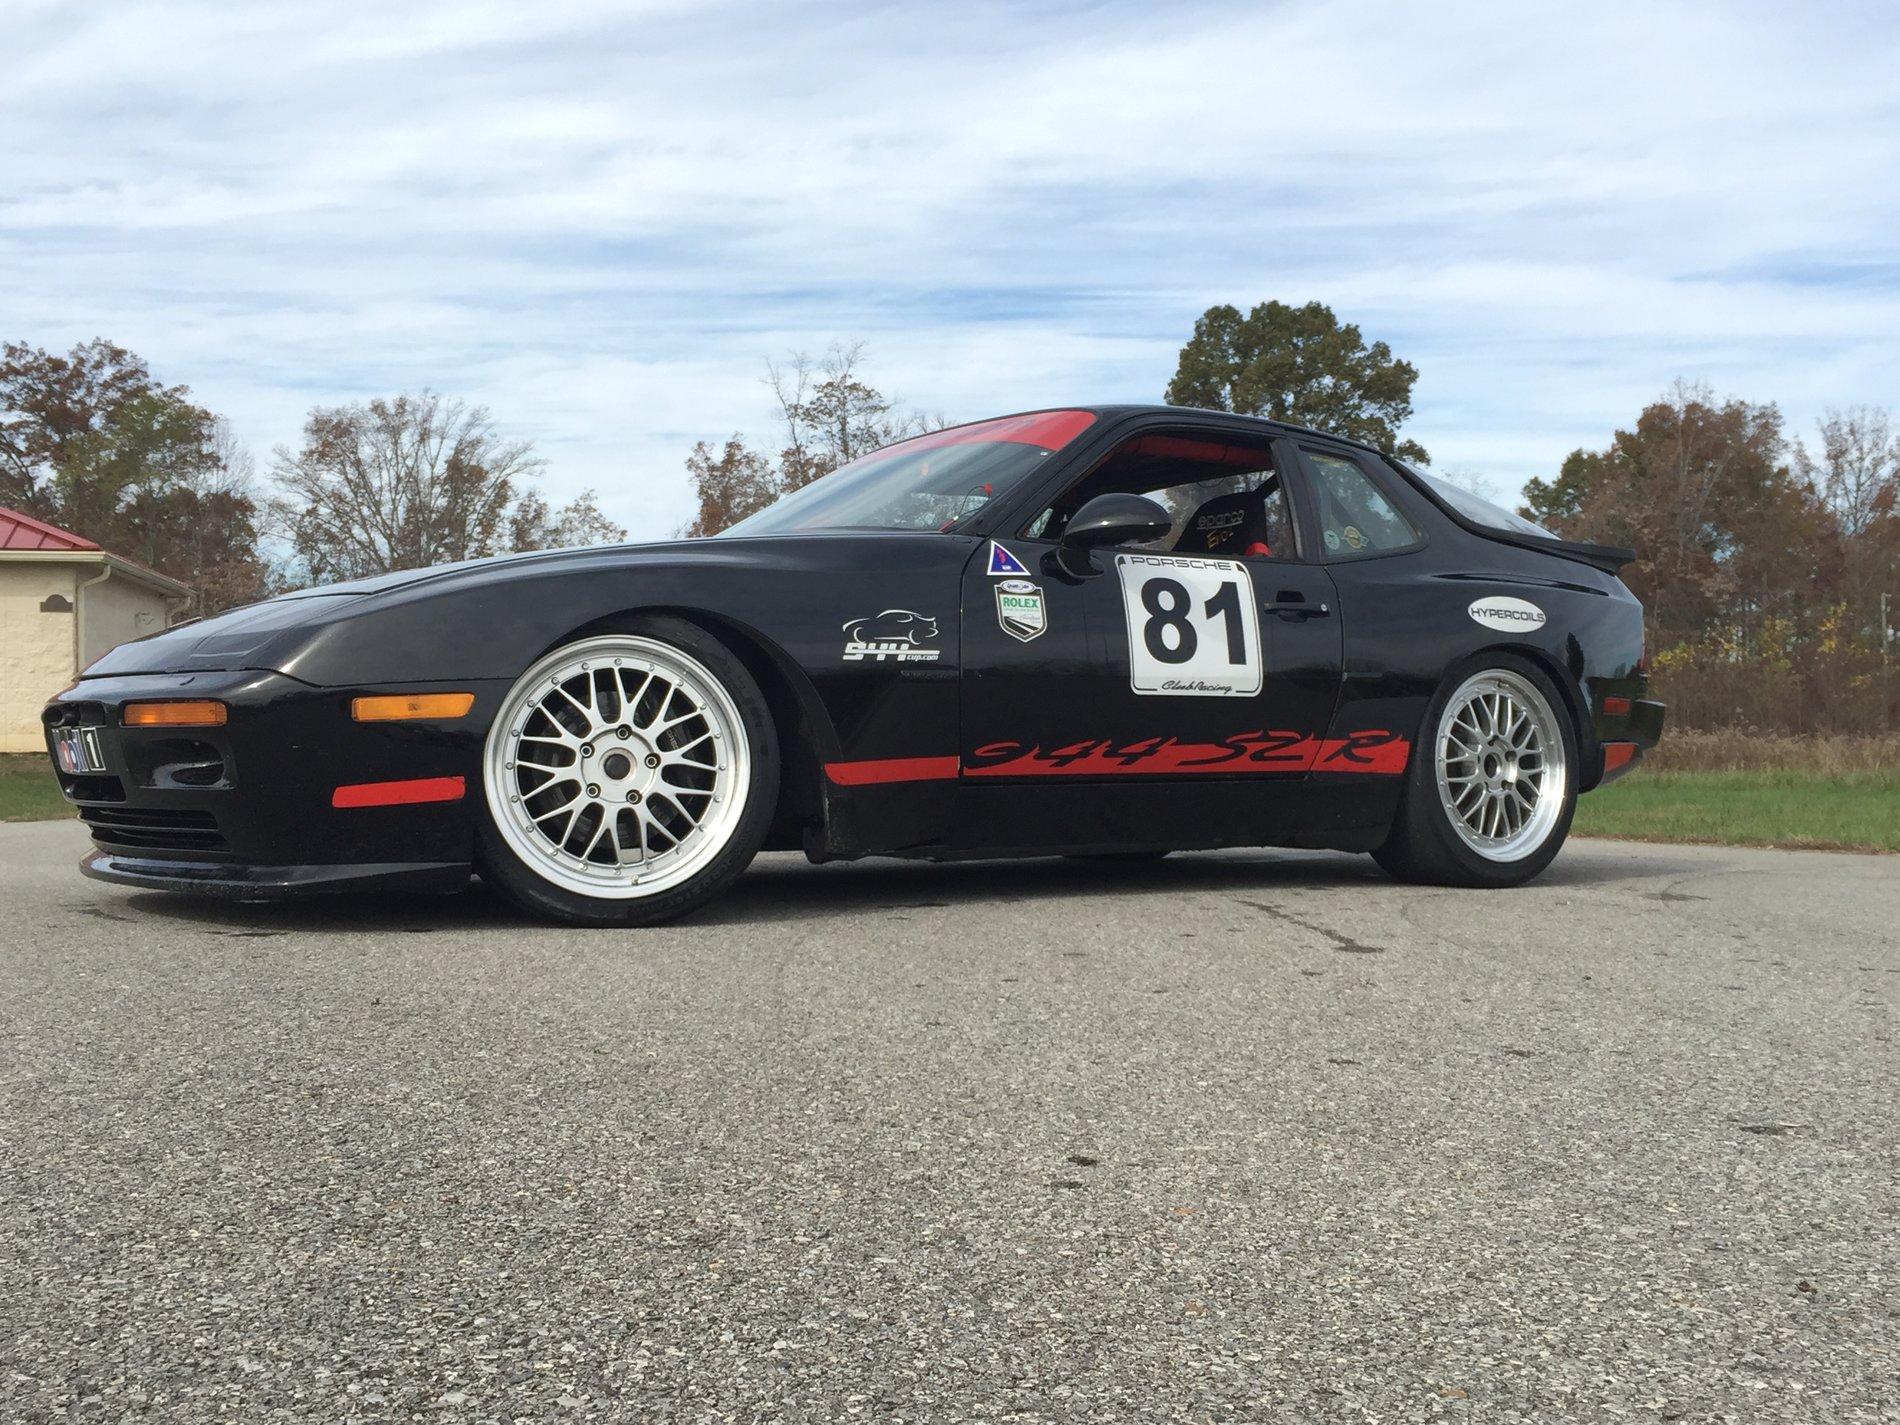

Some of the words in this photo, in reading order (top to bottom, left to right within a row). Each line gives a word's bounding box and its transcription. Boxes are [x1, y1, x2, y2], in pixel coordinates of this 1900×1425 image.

[1129, 556, 1232, 571] PORSCHE
[1003, 596, 1039, 609] ROLEX
[1141, 577, 1247, 665] 81
[1470, 606, 1545, 623] HYPERCOILS
[1194, 681, 1233, 695] Racing
